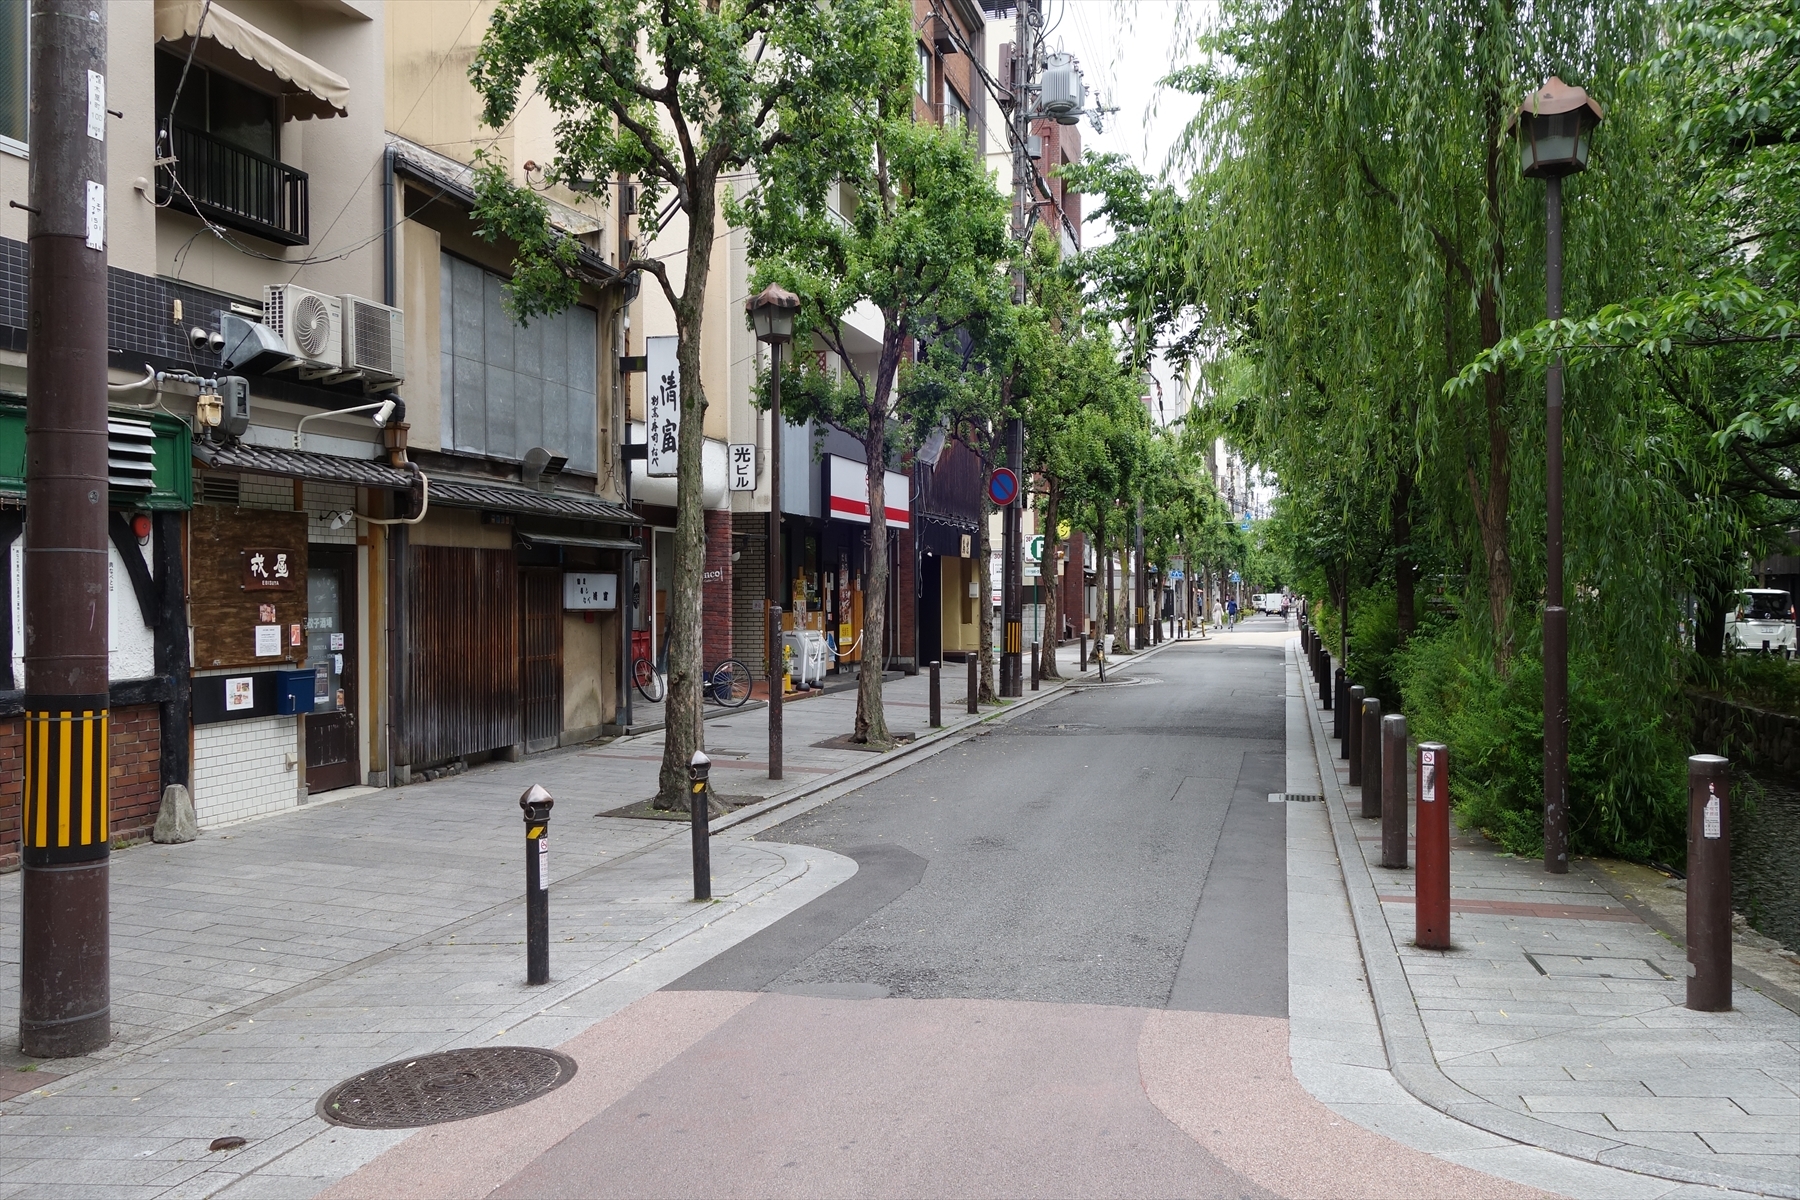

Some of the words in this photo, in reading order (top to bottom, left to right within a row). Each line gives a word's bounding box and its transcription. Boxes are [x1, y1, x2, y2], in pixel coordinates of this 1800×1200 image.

[660, 370, 678, 455] 清富
[734, 446, 751, 488] 光ビル
[307, 616, 333, 629] 餃子酒場
